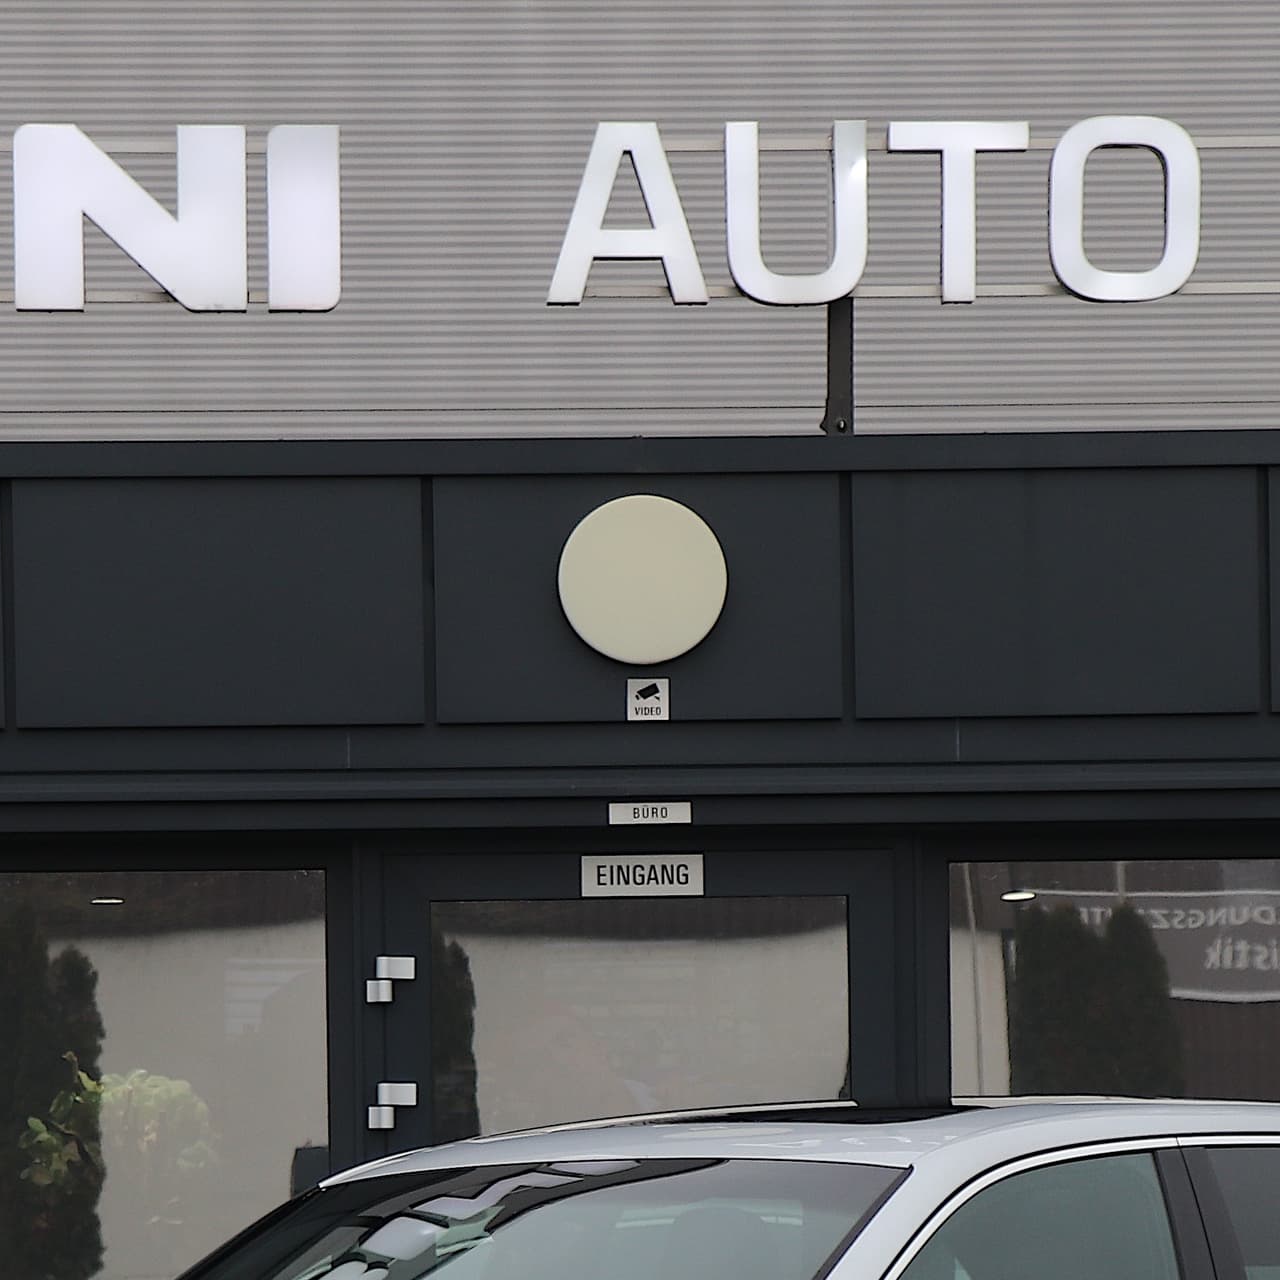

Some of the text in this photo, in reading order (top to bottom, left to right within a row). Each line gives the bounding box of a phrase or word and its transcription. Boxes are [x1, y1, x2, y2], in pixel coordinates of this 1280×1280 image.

[546, 114, 1201, 306] AUTO
[634, 706, 661, 715] VIDEO
[632, 804, 668, 818] BÜRO
[596, 863, 690, 886] EINGANG
